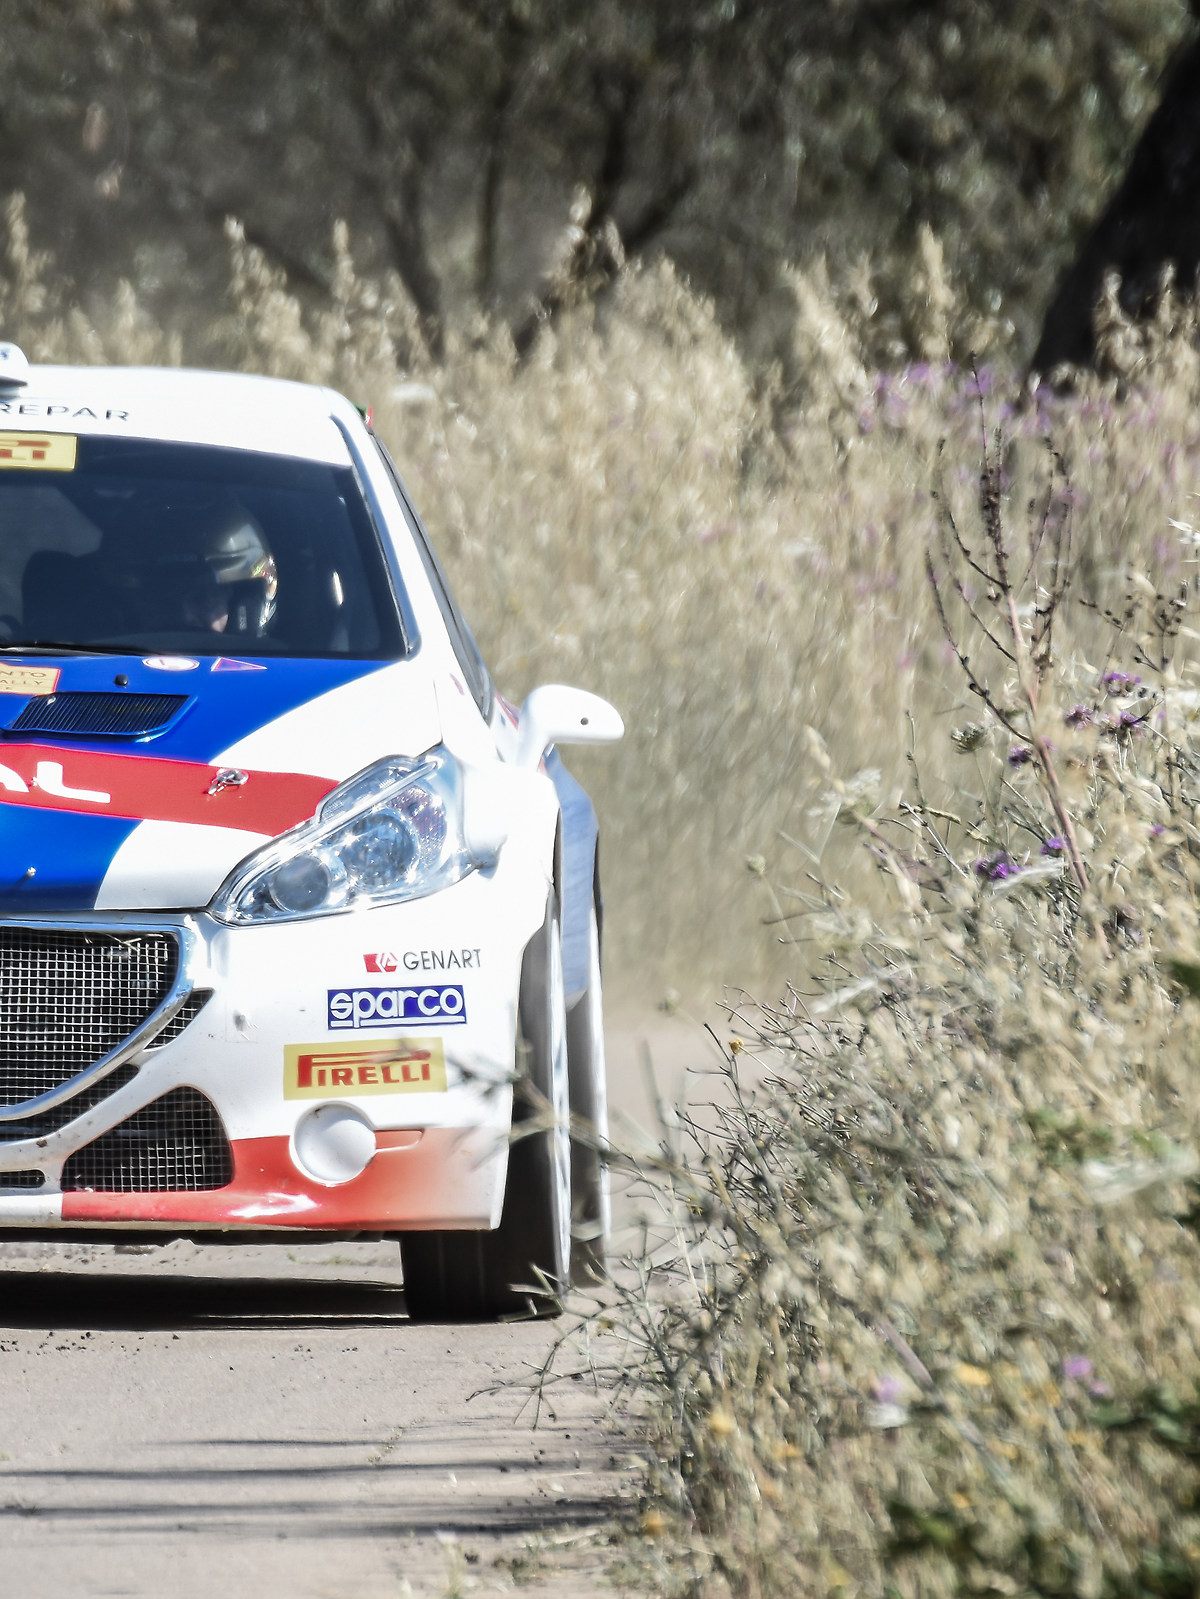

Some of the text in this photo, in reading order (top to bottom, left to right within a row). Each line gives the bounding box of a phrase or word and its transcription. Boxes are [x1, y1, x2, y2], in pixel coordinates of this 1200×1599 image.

[403, 949, 481, 971] GENART
[330, 988, 464, 1029] sparco
[297, 1048, 432, 1089] PIRELLI
